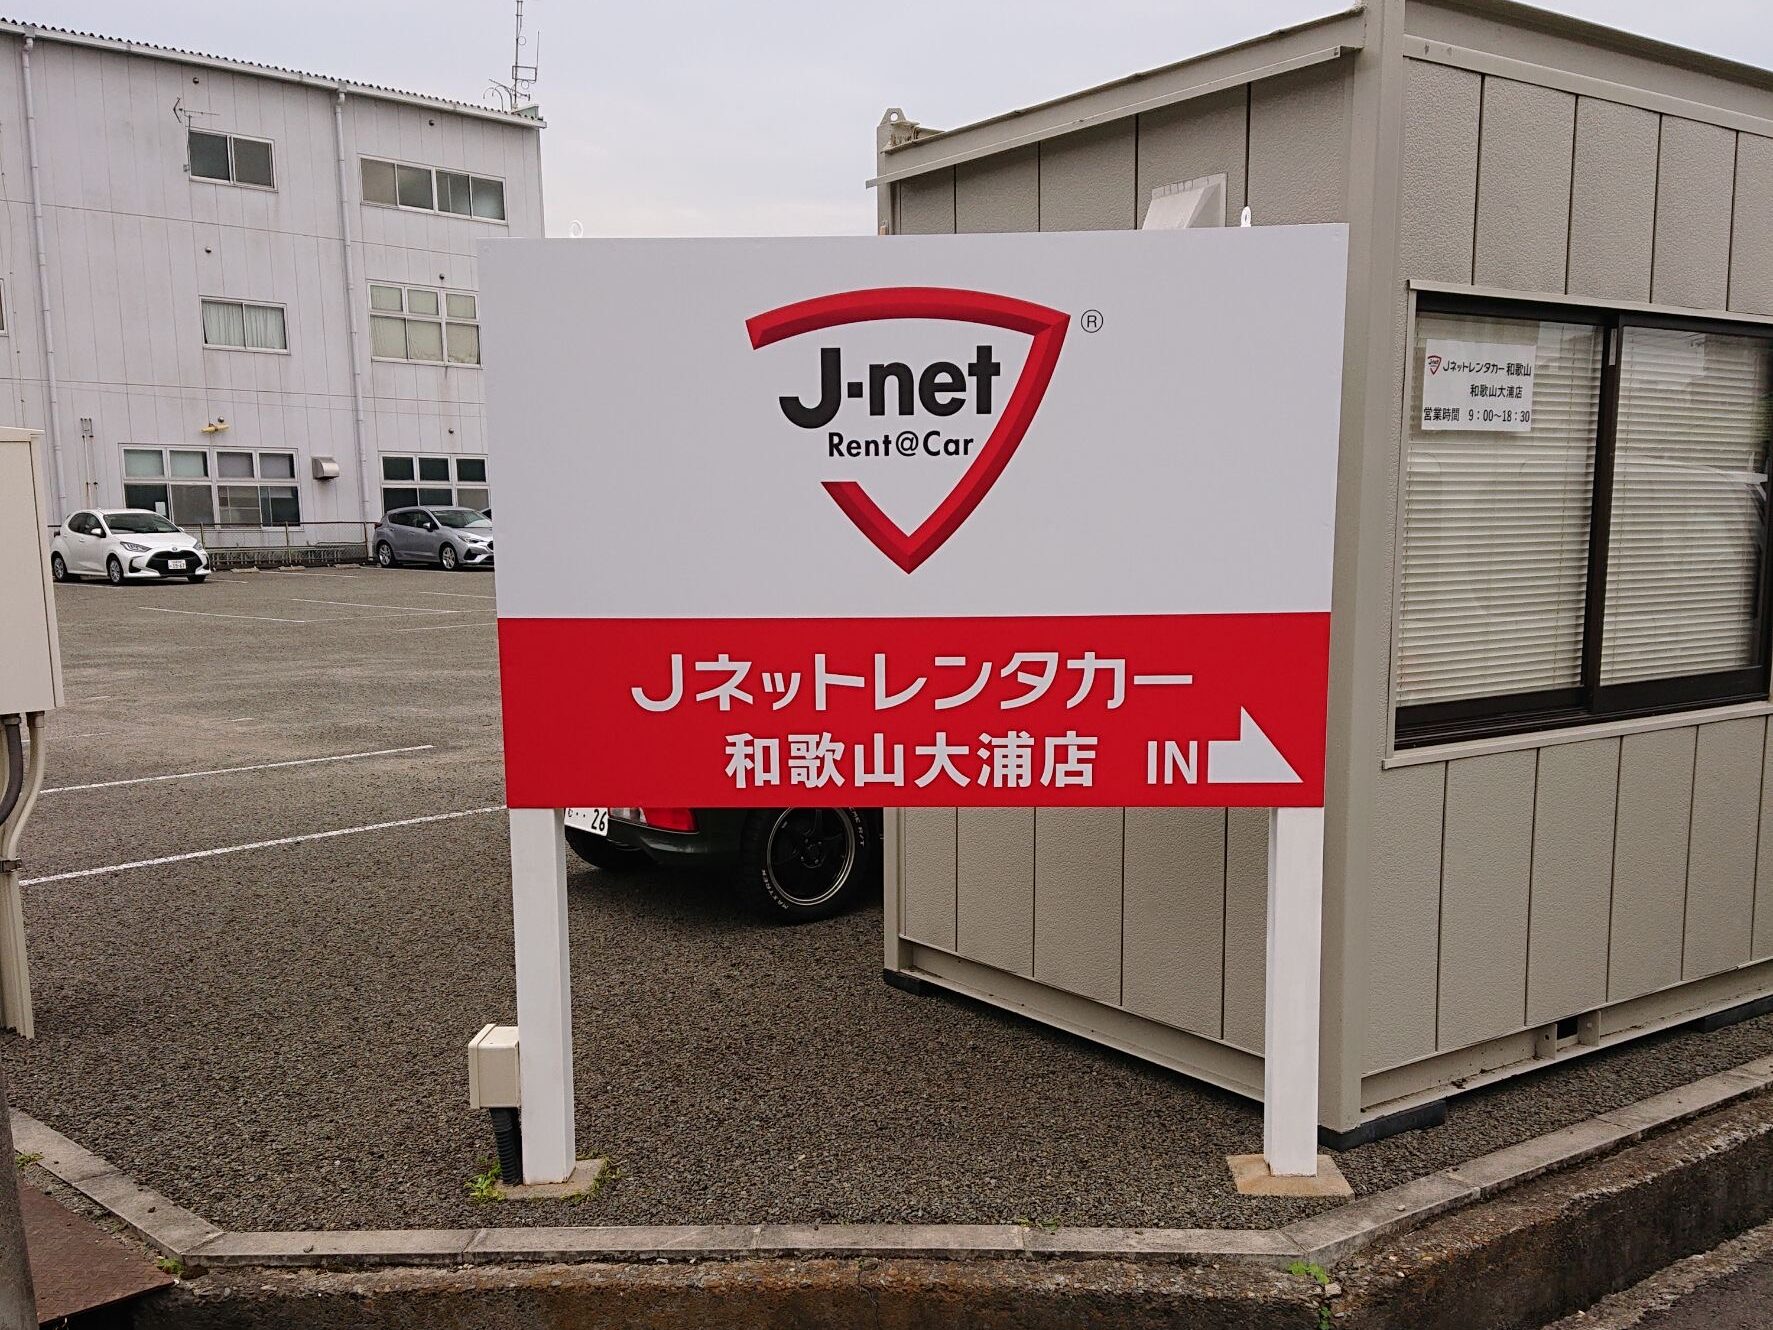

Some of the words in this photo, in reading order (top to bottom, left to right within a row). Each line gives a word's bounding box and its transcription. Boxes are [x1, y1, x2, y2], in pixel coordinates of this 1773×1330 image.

[778, 345, 1001, 429] J-net
[1423, 407, 1460, 421] 営業時間
[828, 430, 974, 457] Rent@Car
[631, 652, 1193, 712] Jネットレンタカー
[724, 731, 1098, 789] 和歌山大浦店
[1147, 740, 1198, 785] IN
